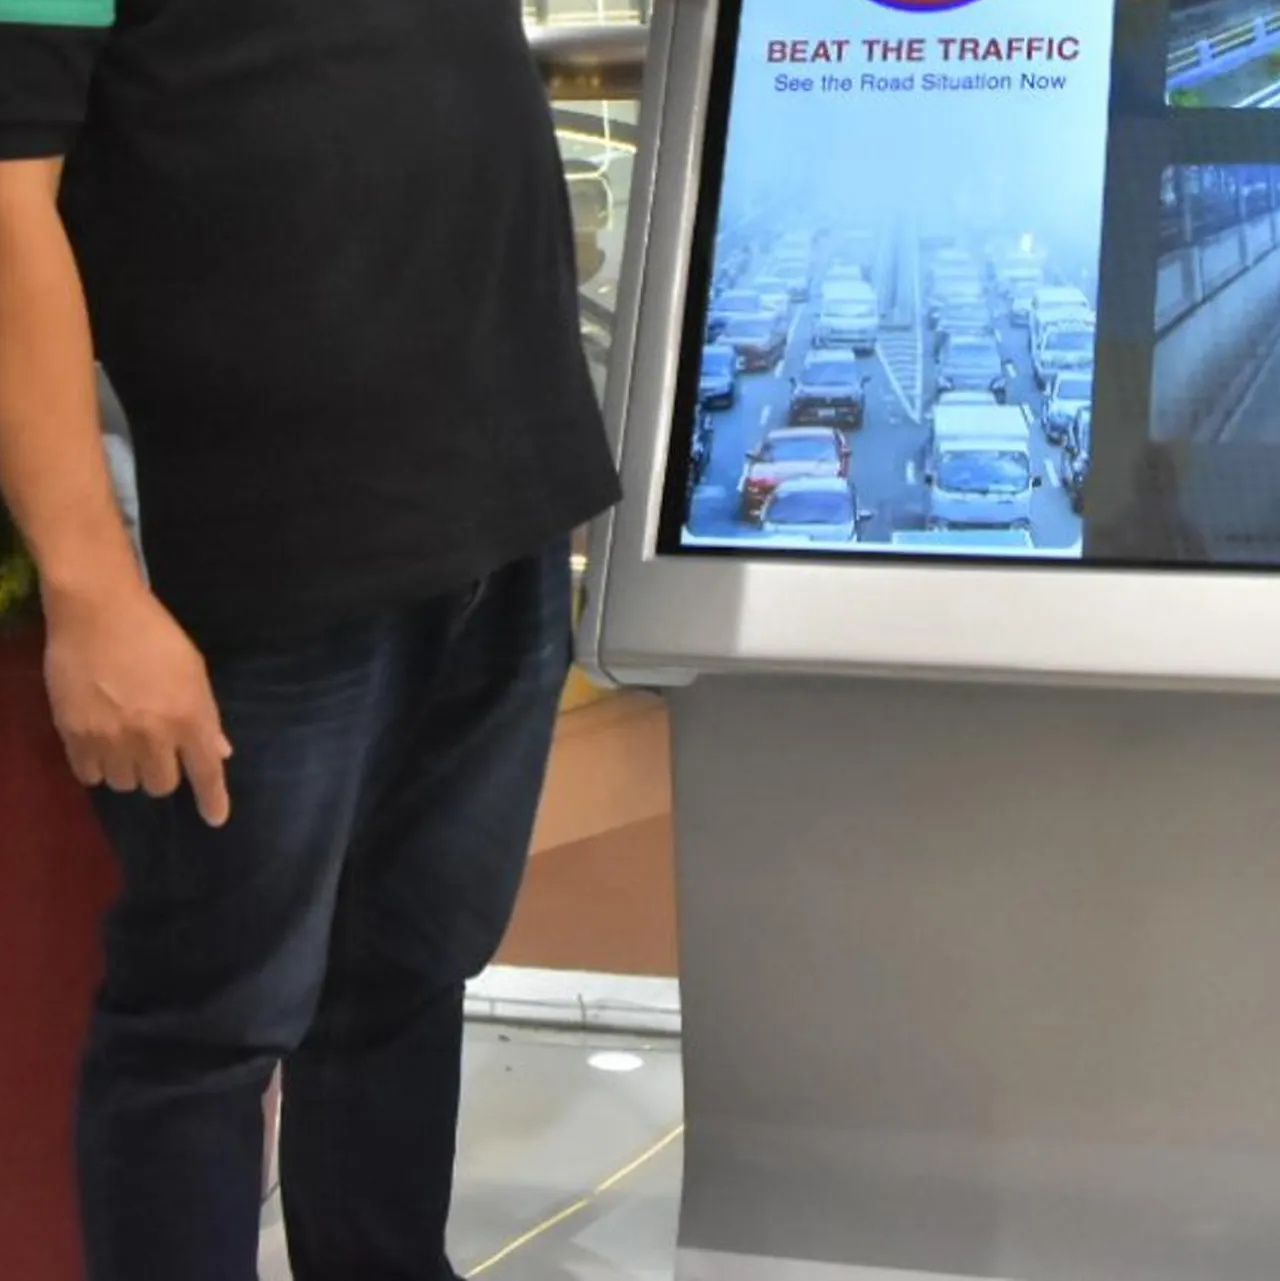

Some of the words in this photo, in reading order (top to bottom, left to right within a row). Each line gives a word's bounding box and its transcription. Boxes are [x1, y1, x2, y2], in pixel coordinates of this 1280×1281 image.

[766, 39, 851, 63] BEAT
[862, 38, 925, 62] THE
[937, 36, 1080, 61] TRAFFIC
[774, 74, 814, 92] See
[821, 73, 852, 91] the
[860, 73, 915, 91] Road
[921, 72, 1011, 91] Situation
[1020, 71, 1066, 90] Now
